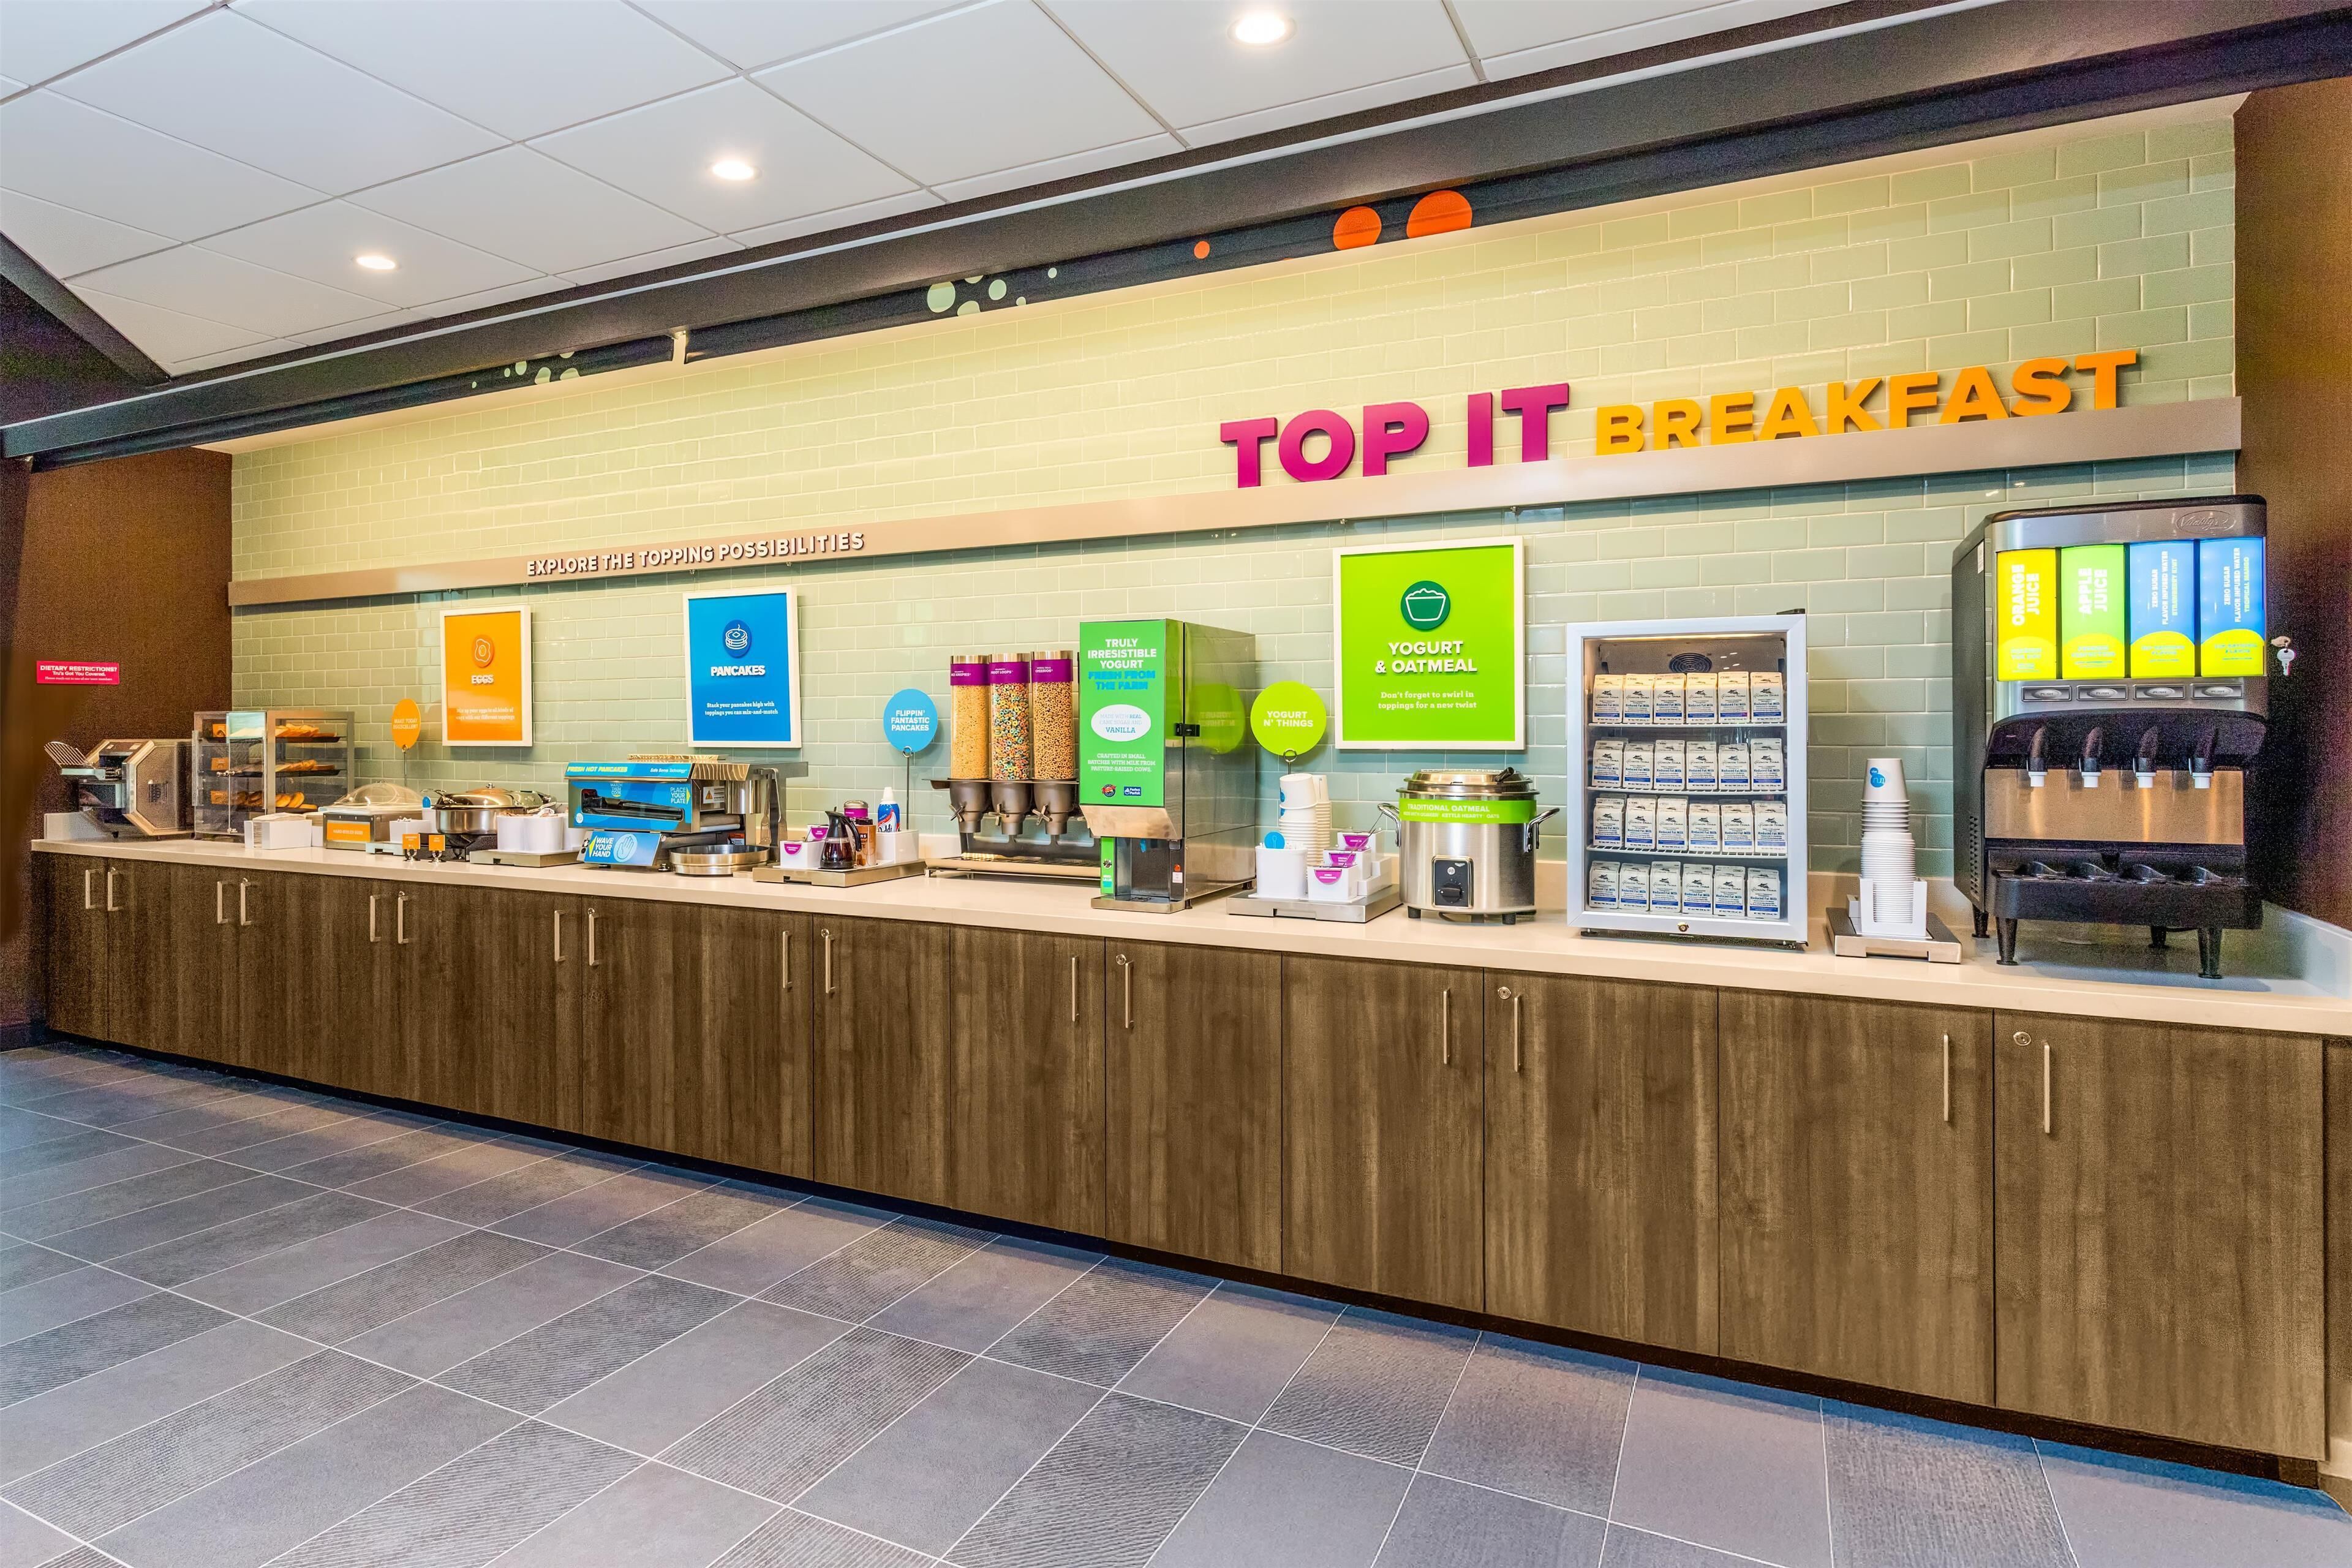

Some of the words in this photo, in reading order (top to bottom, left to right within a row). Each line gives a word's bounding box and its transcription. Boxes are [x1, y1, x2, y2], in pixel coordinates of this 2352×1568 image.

[1220, 401, 1430, 489] TOP
[1468, 383, 1570, 469] IT
[1596, 350, 2136, 456] BREAKFAST
[527, 556, 598, 575] EXPLORE
[601, 552, 635, 570] THE
[639, 545, 714, 567] TOPPING
[718, 532, 864, 560] POSSIBILITIES
[2011, 564, 2025, 626] ORANGE
[2026, 573, 2040, 616] JUICE
[2078, 568, 2092, 615] APPLE
[2094, 569, 2108, 612] JUICE
[1105, 638, 1139, 647] TRULY
[1388, 641, 1463, 655] YOGURT
[1088, 649, 1157, 658] IRRESISTIBLE
[710, 665, 766, 677] PANCAKES
[1100, 660, 1144, 669] YOGURT
[1375, 660, 1387, 673] &
[1392, 658, 1477, 673] OATMEAL
[471, 675, 494, 684] EGGS
[1124, 670, 1156, 679] FROM
[1095, 681, 1116, 690] THE
[1404, 691, 1430, 699] forget
